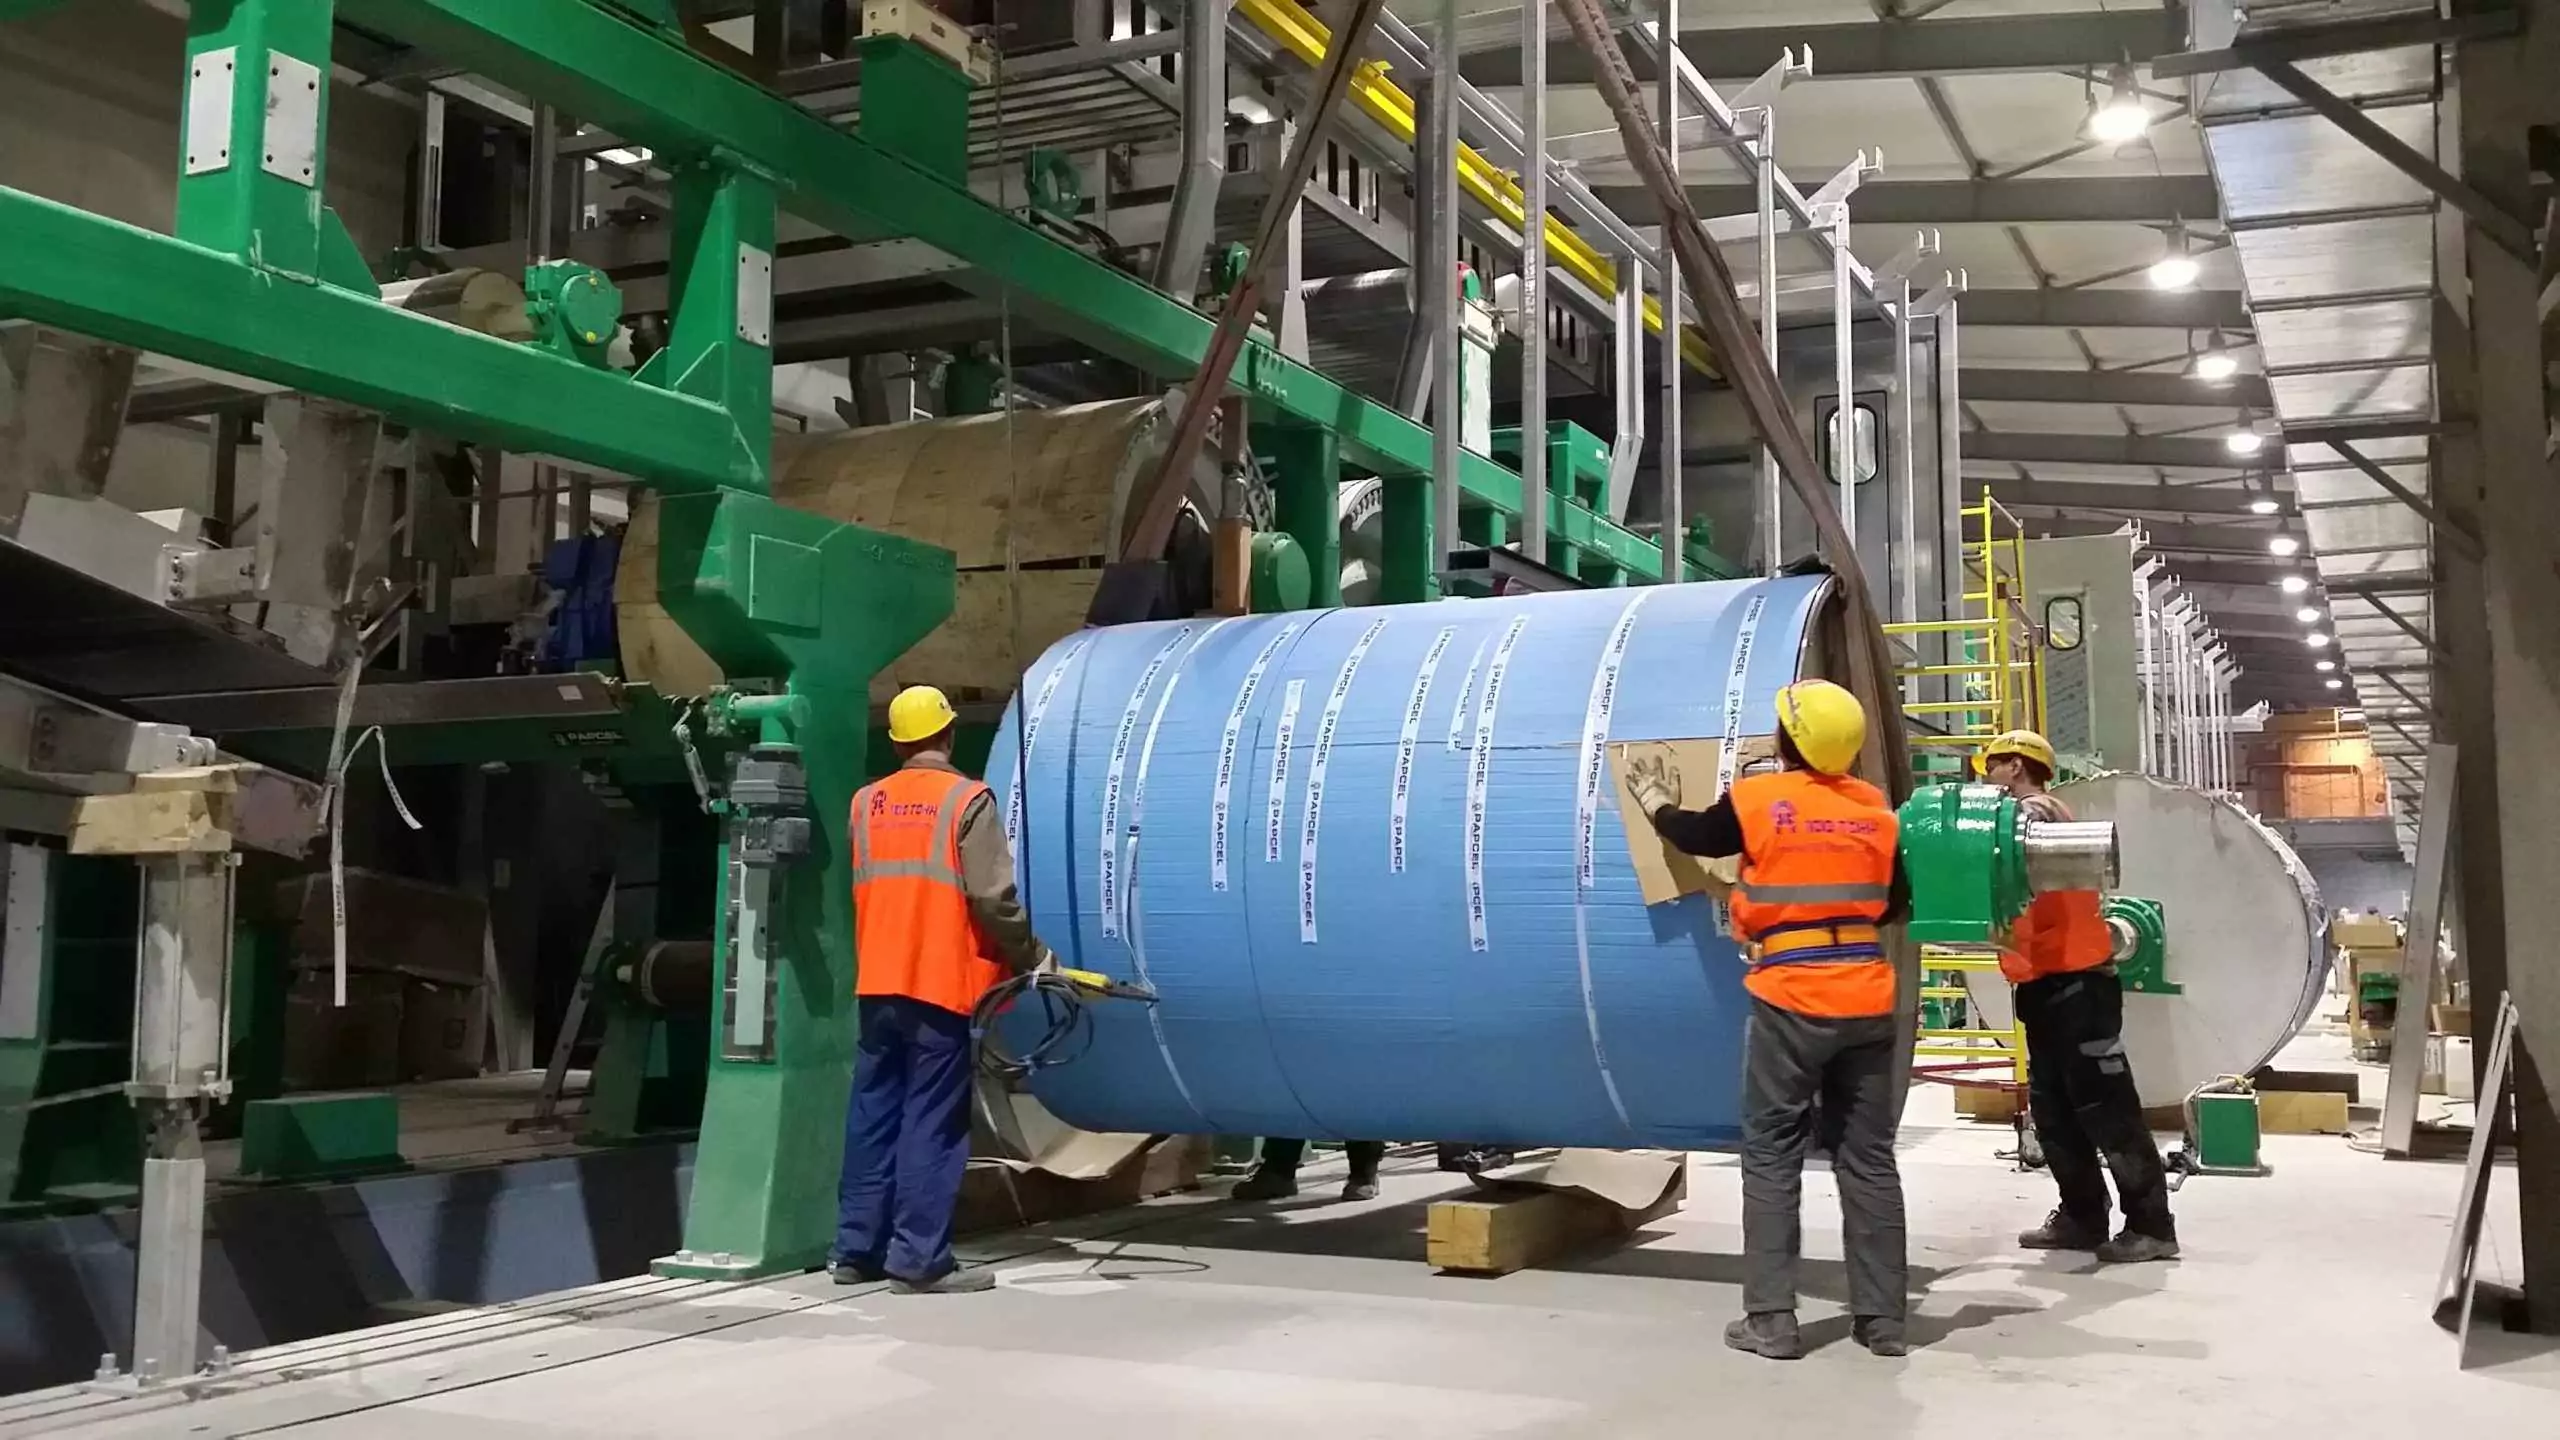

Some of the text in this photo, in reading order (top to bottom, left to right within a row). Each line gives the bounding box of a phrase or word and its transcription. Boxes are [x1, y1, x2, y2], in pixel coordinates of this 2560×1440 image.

[1335, 661, 1356, 698] PAPCEL
[1735, 637, 1750, 677] PAPCEL
[1235, 680, 1256, 718] PAPCEL
[1409, 681, 1427, 724] PAPCEL
[1484, 670, 1501, 713] PAPCEL
[1115, 718, 1133, 761] PAPCEL
[1316, 719, 1333, 767] PAPCEL
[1724, 701, 1739, 754] PAPCEL
[1220, 738, 1234, 788] PAPCEL
[1397, 748, 1411, 799] PAPCEL
[1476, 736, 1489, 786] PAPCEL
[1588, 743, 1602, 798] PAPCEL
[1009, 791, 1022, 841] PAPCEL
[1106, 784, 1118, 835] PAPCEL
[1270, 734, 1289, 860] PAPCEL PAPCEL
[1306, 792, 1319, 846] PAPCEL
[1216, 812, 1225, 866] PAPCEL
[1471, 813, 1482, 870] PAPCEL
[1105, 861, 1113, 914] PAPCEL
[1304, 872, 1313, 927] PAPCEL
